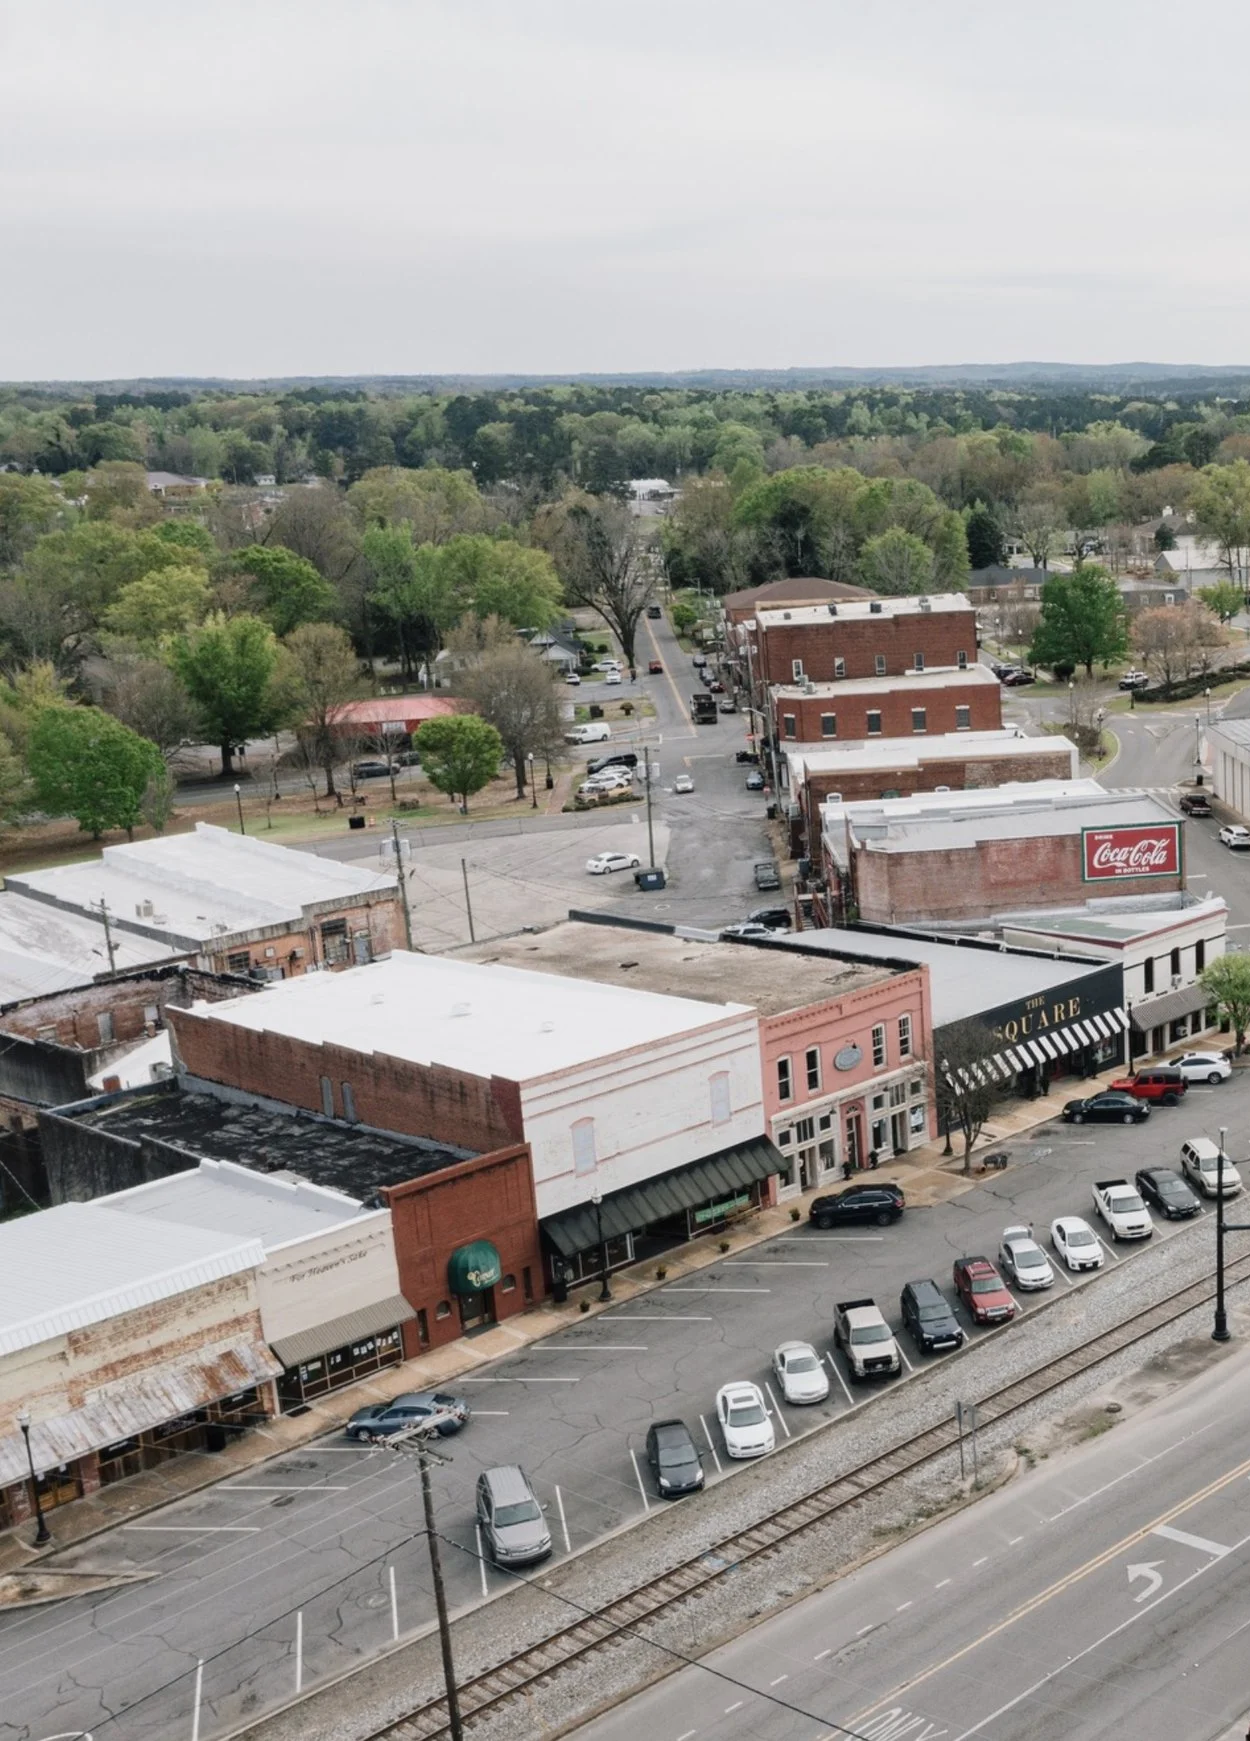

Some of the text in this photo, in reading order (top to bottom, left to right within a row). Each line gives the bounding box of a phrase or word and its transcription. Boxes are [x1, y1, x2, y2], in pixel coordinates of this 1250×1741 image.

[1123, 866, 1150, 874] BOTTLES
[1025, 995, 1045, 1010] THE
[993, 996, 1081, 1043] SQUARE
